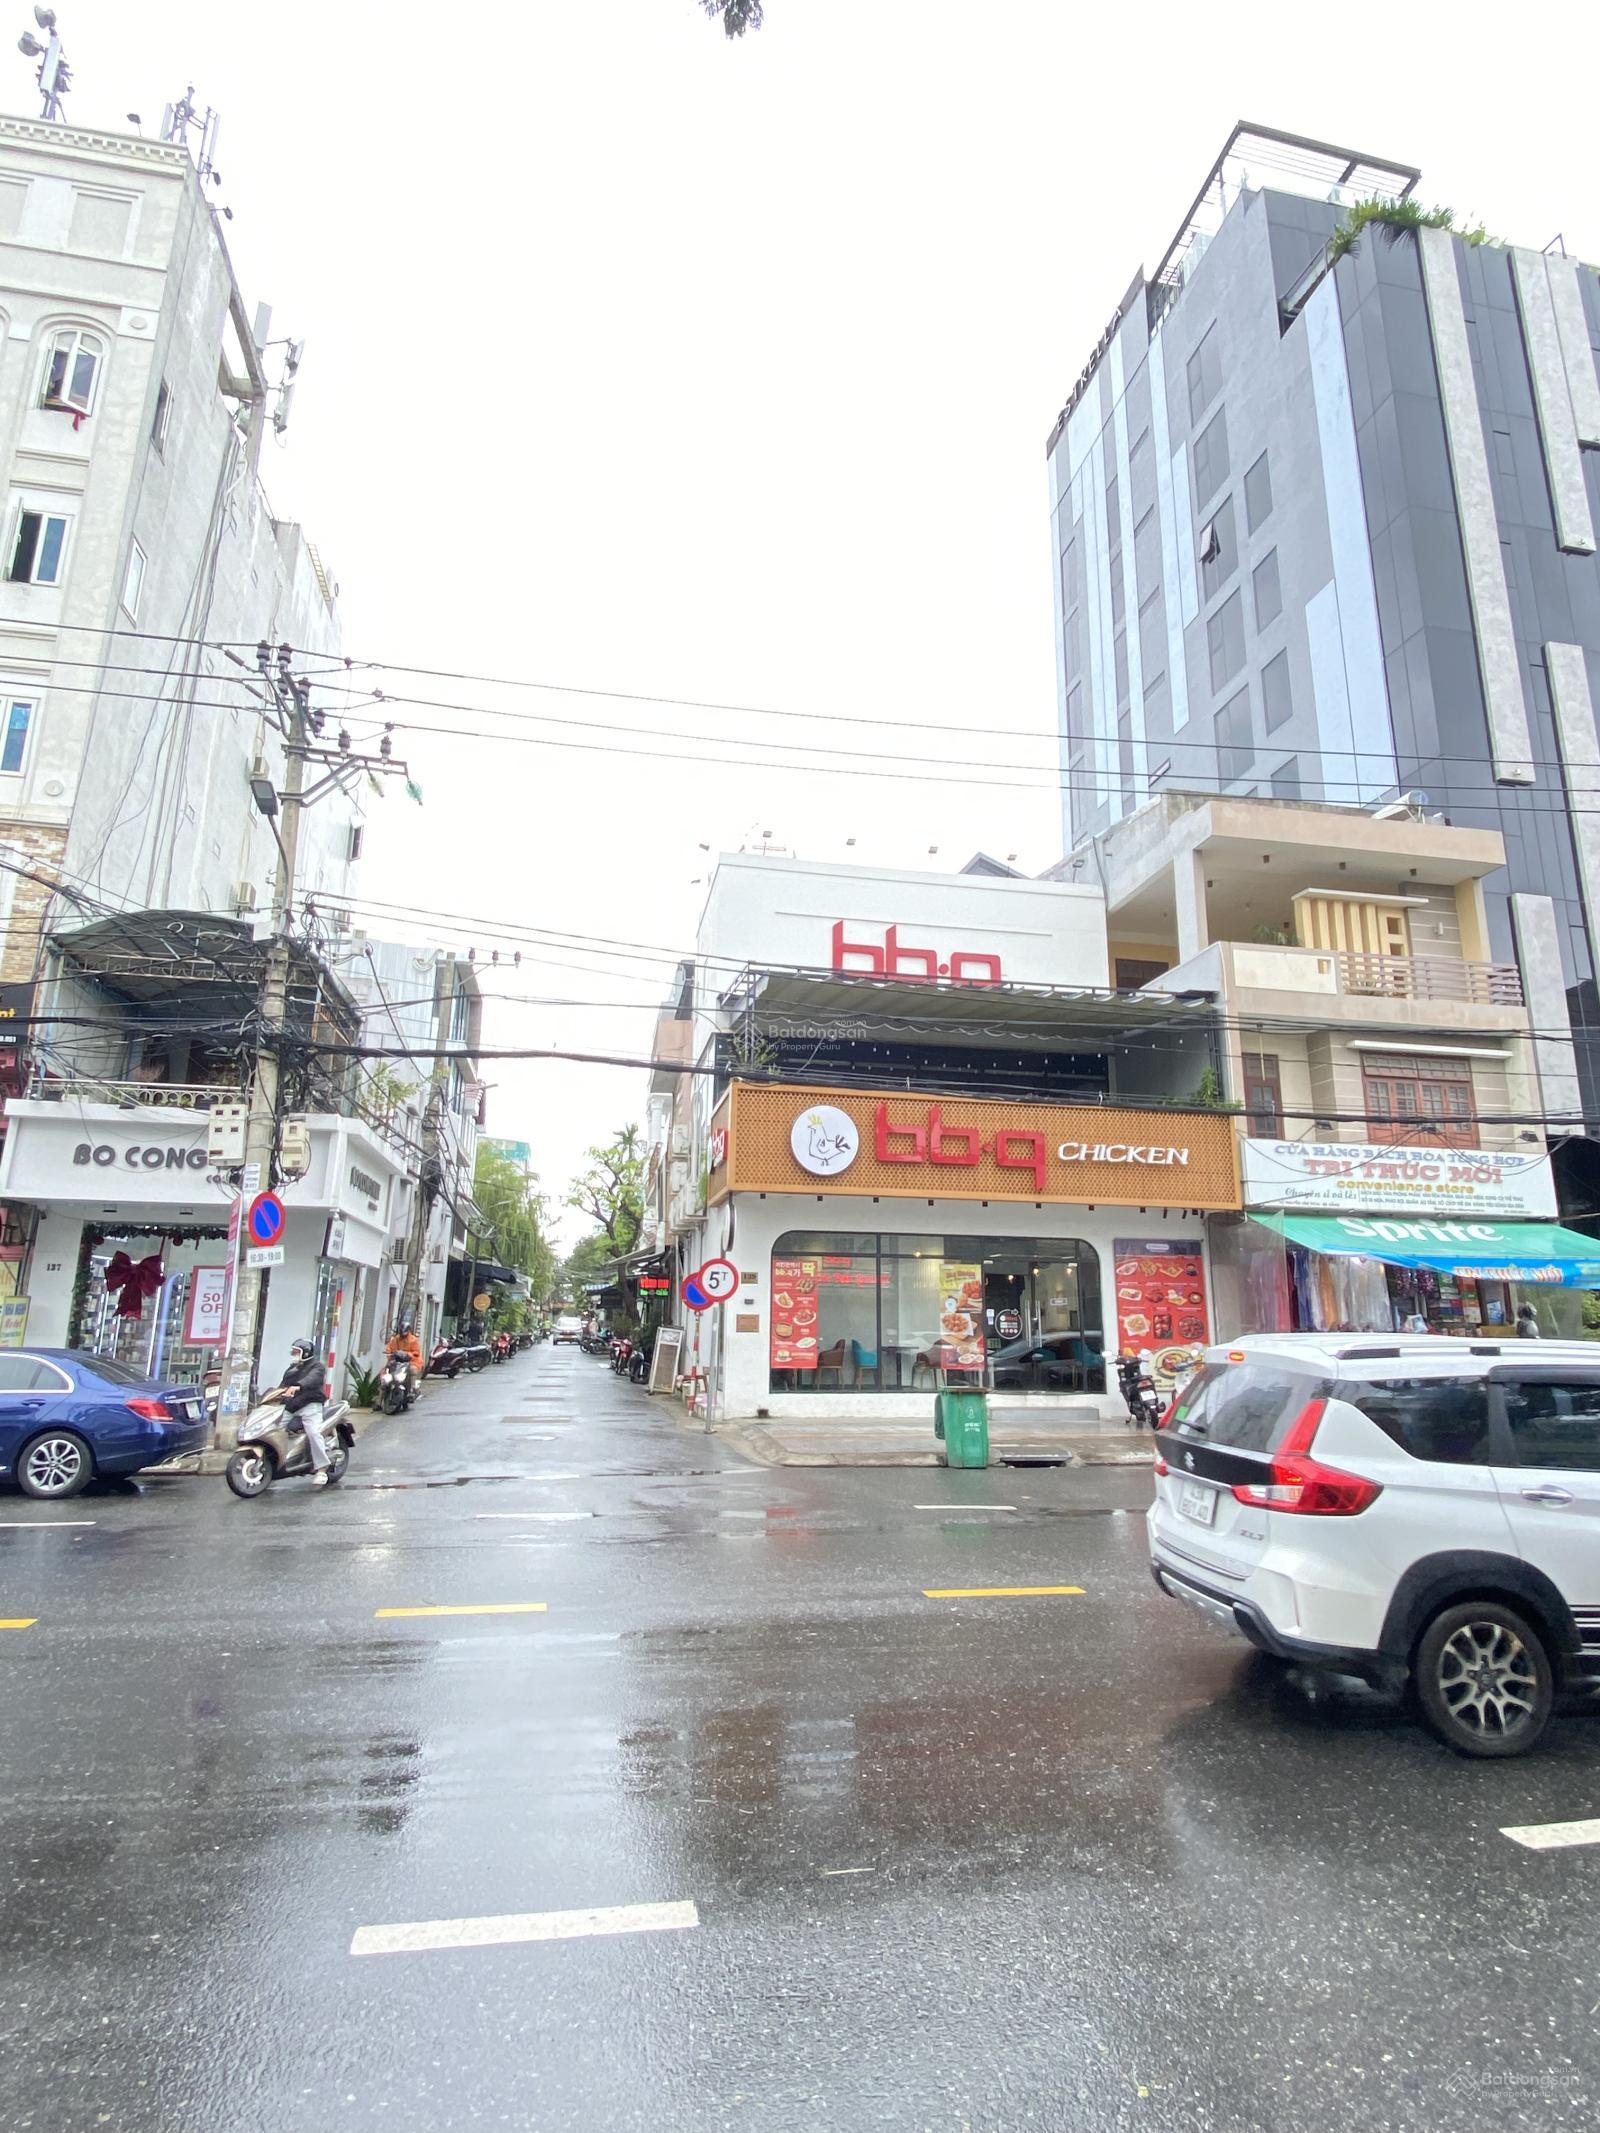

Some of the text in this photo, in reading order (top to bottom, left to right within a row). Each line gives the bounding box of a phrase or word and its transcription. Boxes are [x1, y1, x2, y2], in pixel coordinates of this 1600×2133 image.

[73, 1143, 209, 1170] BO CONG
[1057, 1141, 1189, 1166] CHICKEN
[1312, 1146, 1359, 1158] HÀNG
[1336, 1179, 1475, 1194] convenience store
[1336, 1215, 1504, 1242] Sprite
[202, 1292, 225, 1303] 50
[201, 1303, 224, 1313] OF
